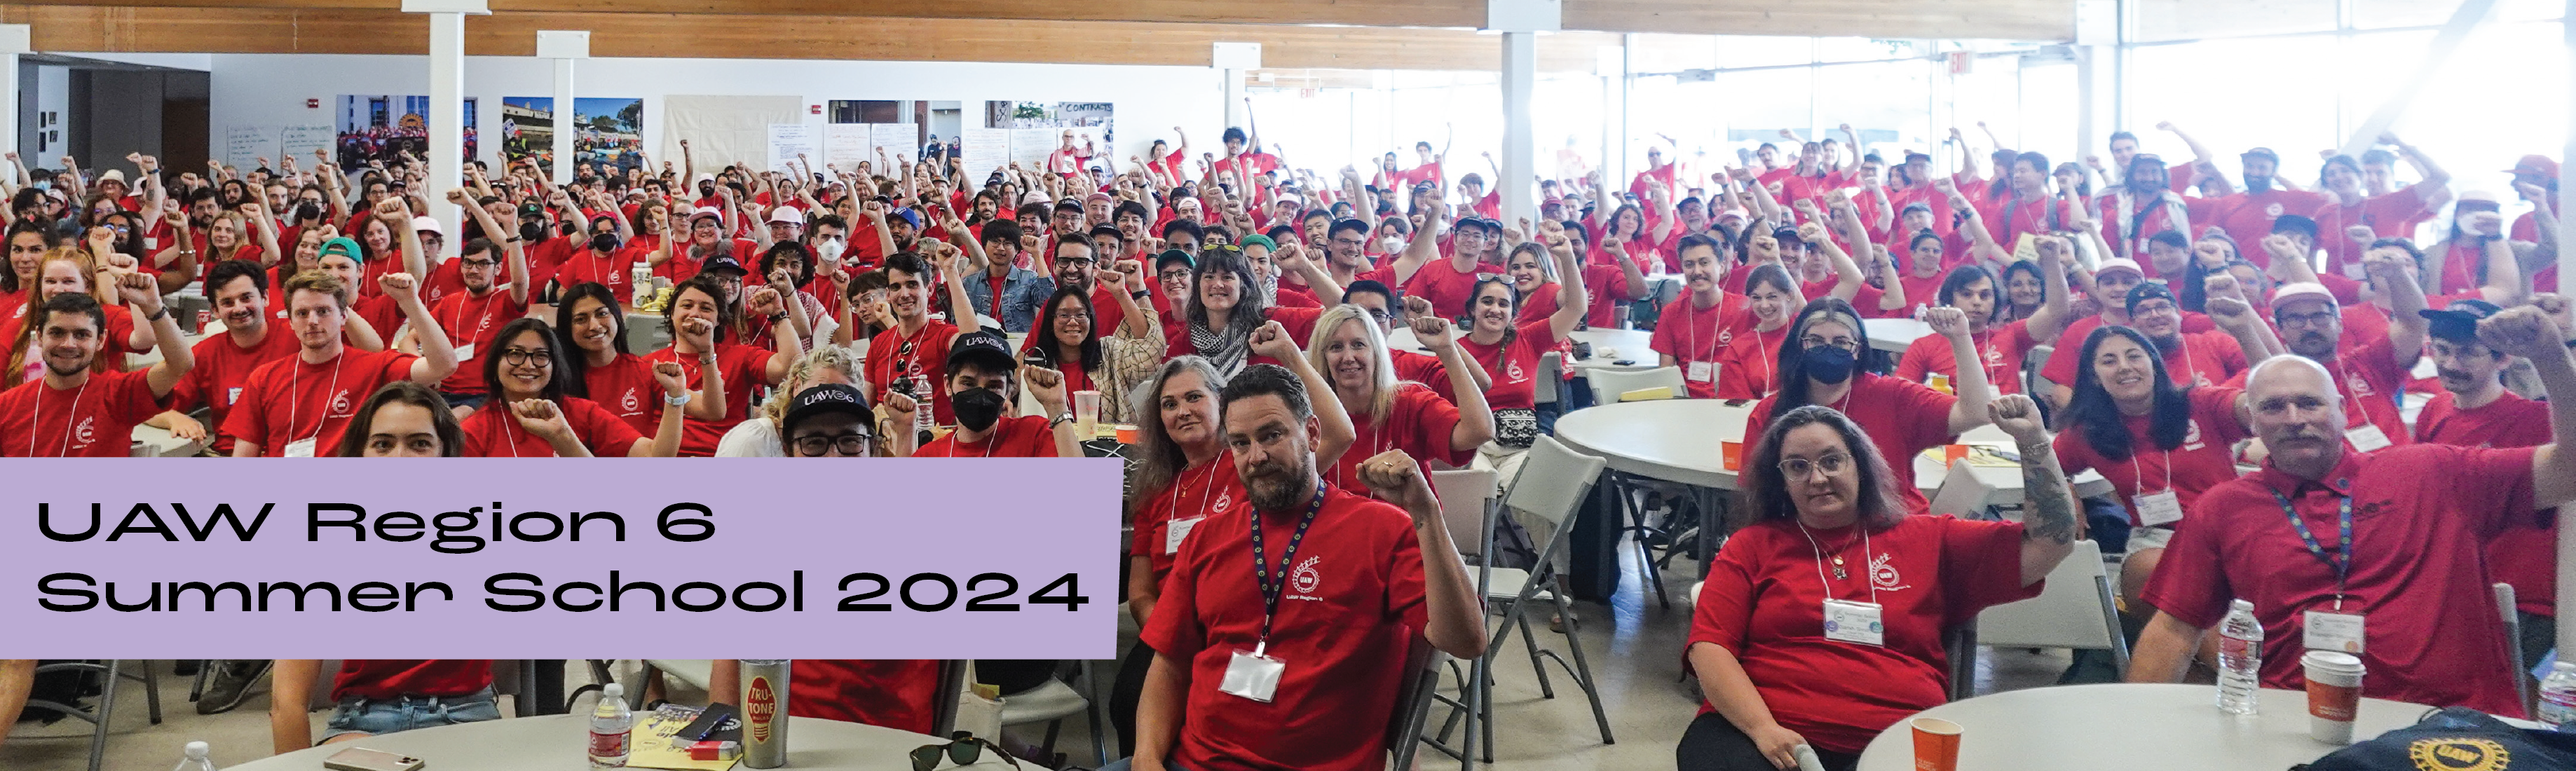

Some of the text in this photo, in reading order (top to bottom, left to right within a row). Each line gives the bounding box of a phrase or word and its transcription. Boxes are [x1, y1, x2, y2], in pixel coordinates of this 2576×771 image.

[1301, 88, 1315, 98] EXIT
[1065, 103, 1112, 113] CONTRACTS
[750, 687, 772, 701] TRU-
[748, 702, 775, 714] TONE
[2437, 744, 2481, 763] UAW
